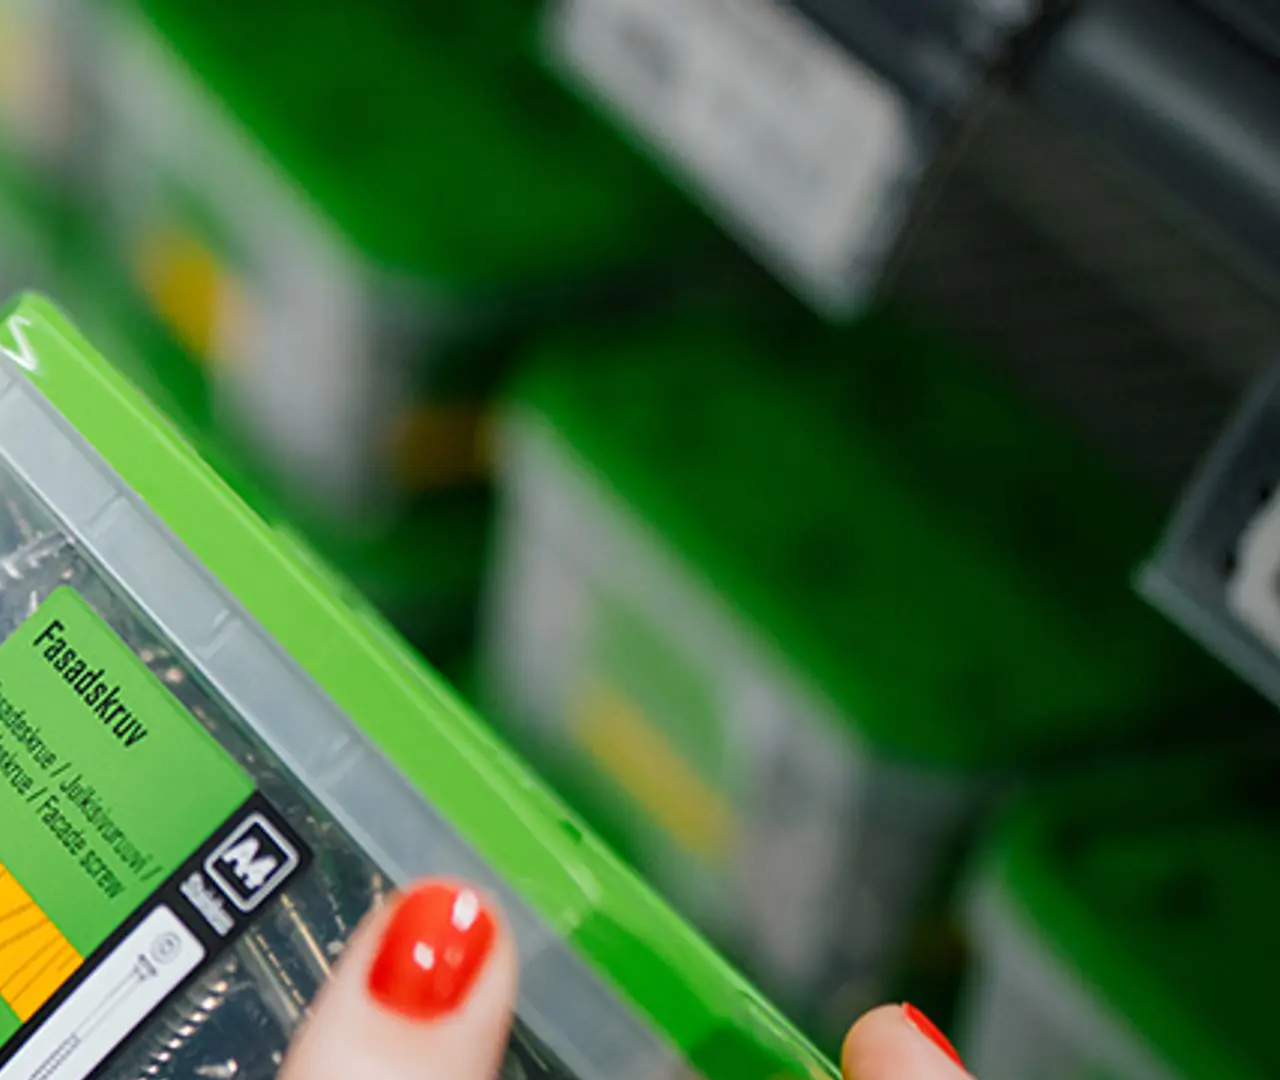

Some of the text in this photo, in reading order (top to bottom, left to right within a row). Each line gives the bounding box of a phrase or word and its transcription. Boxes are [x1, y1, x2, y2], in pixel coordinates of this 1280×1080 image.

[33, 620, 147, 747] Fasadskruv
[36, 795, 87, 856] Facade
[79, 849, 125, 899] screw
[221, 837, 276, 889] A4
